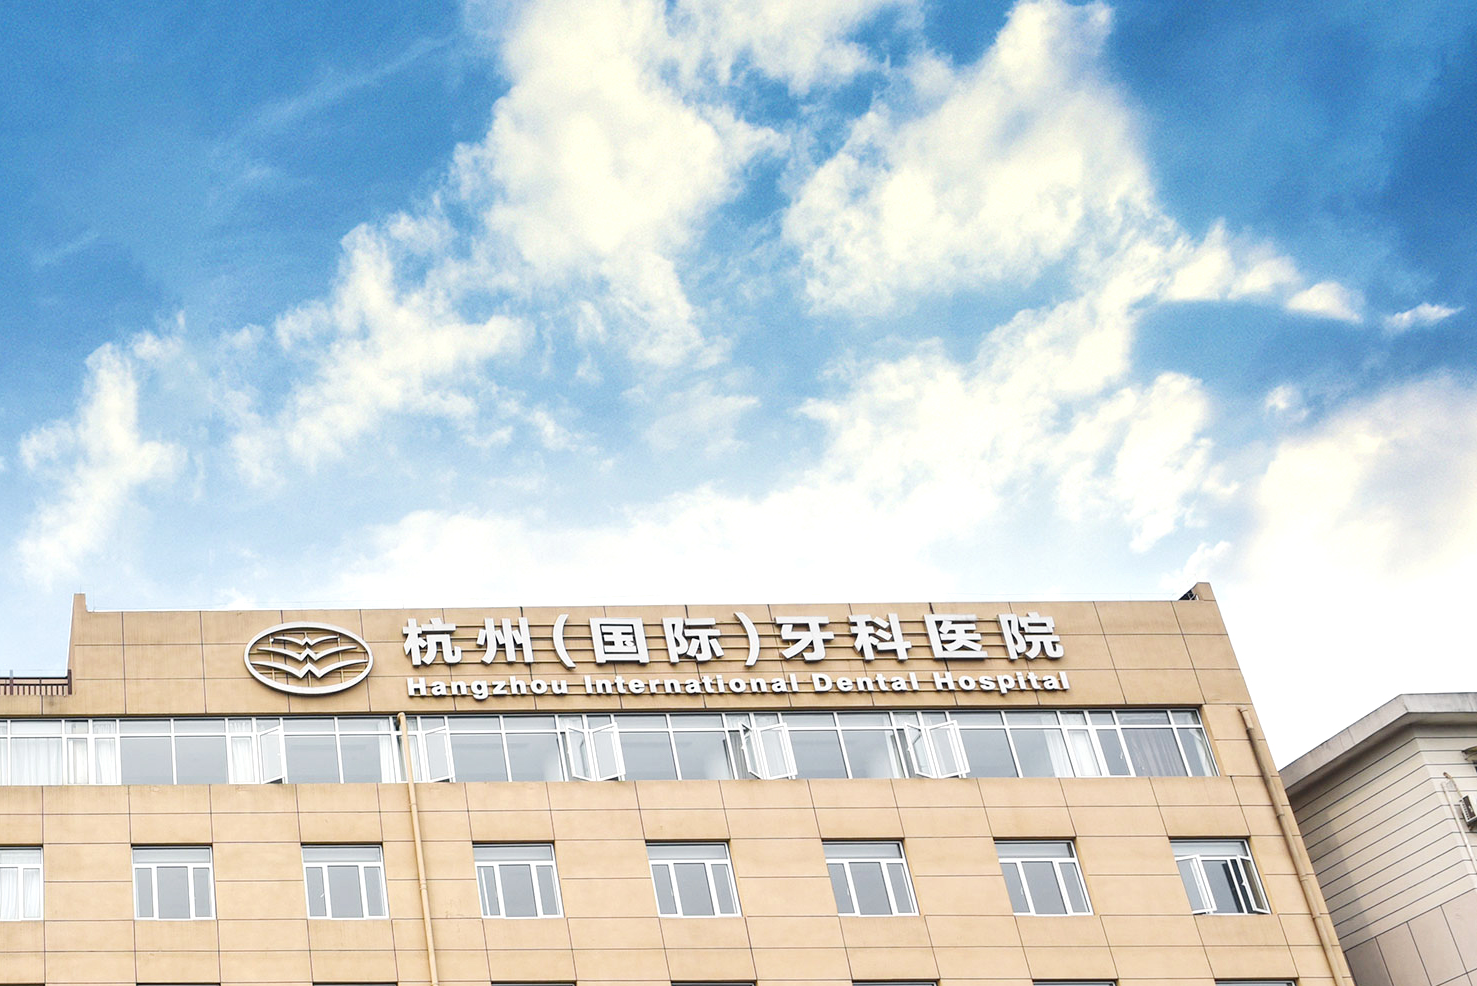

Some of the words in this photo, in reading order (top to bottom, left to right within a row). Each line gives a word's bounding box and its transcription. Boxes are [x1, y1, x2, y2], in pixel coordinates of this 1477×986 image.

[402, 611, 1065, 671] 杭州（国际）牙科医院
[406, 675, 568, 700] Hangzhou
[584, 673, 799, 695] International
[810, 671, 919, 692] Dental
[932, 670, 1070, 695] Hospital
